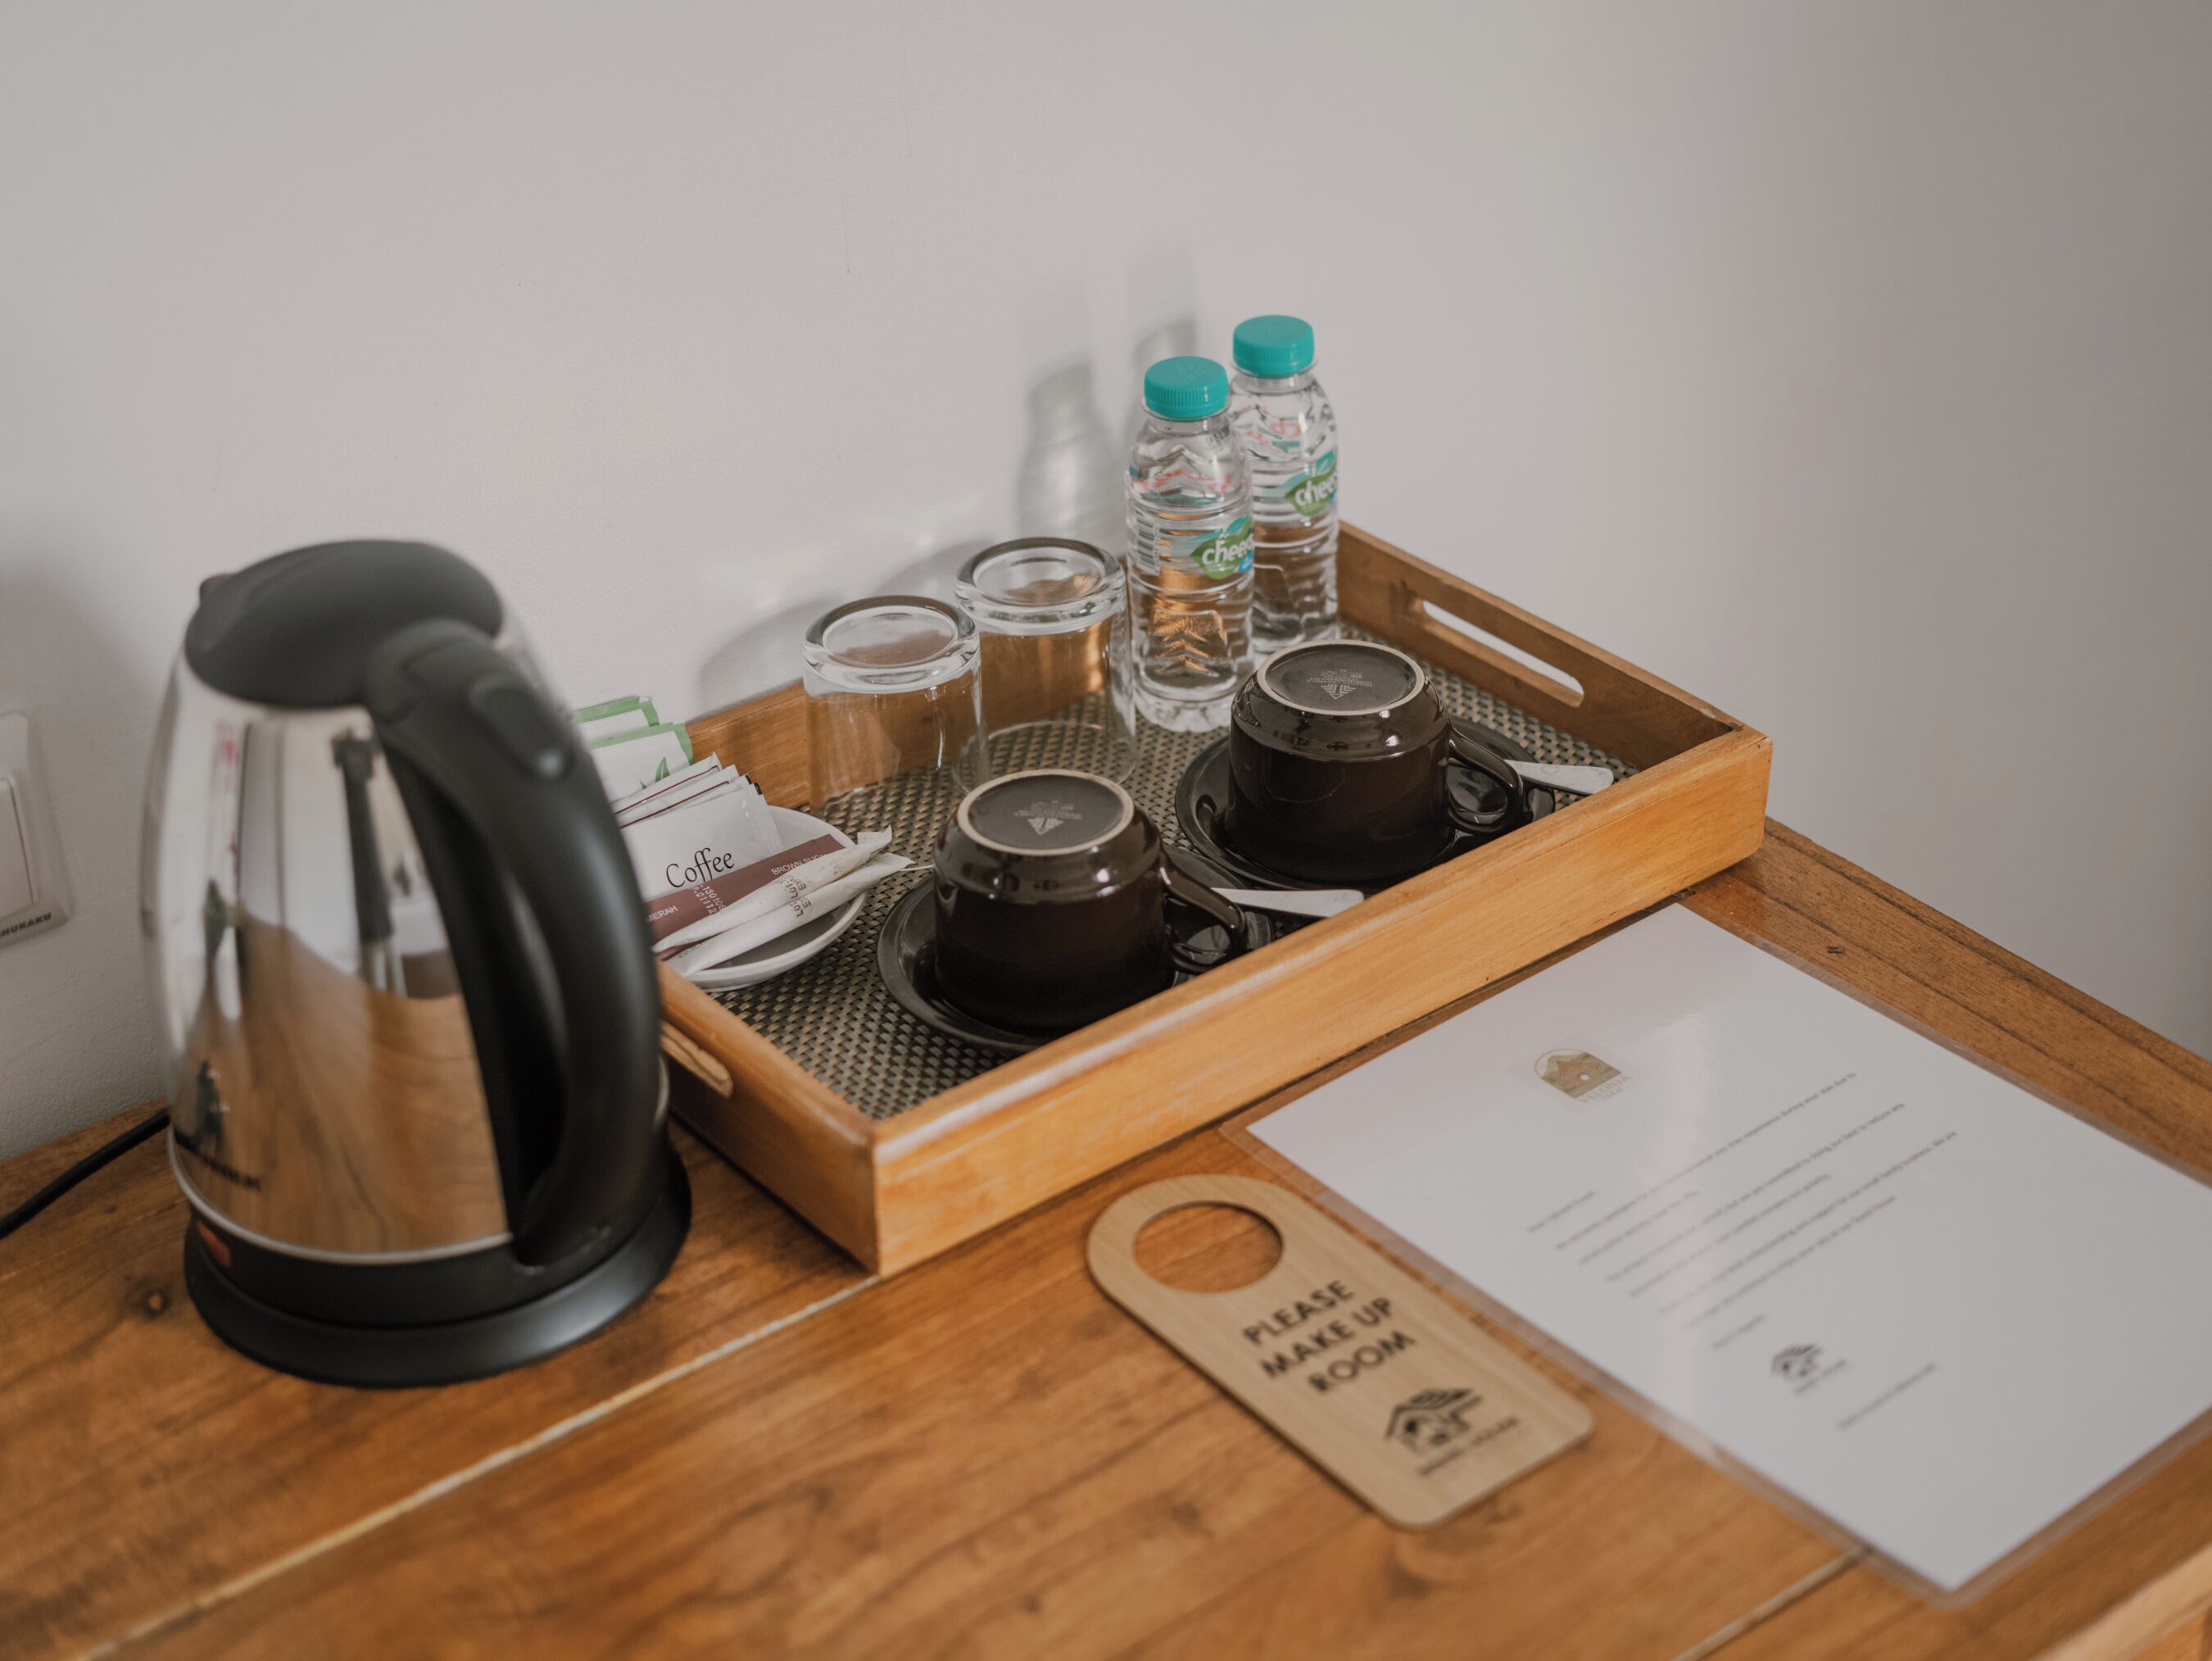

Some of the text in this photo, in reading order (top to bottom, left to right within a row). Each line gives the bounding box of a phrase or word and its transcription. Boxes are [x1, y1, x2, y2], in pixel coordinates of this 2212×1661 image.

[666, 847, 735, 888] Coffee
[771, 860, 802, 875] BROWN
[0, 912, 52, 937] HUKAKU
[1242, 1279, 1355, 1346] PLEASE
[1259, 1296, 1392, 1378] MAKE UP
[1307, 1330, 1417, 1394] ROOM
